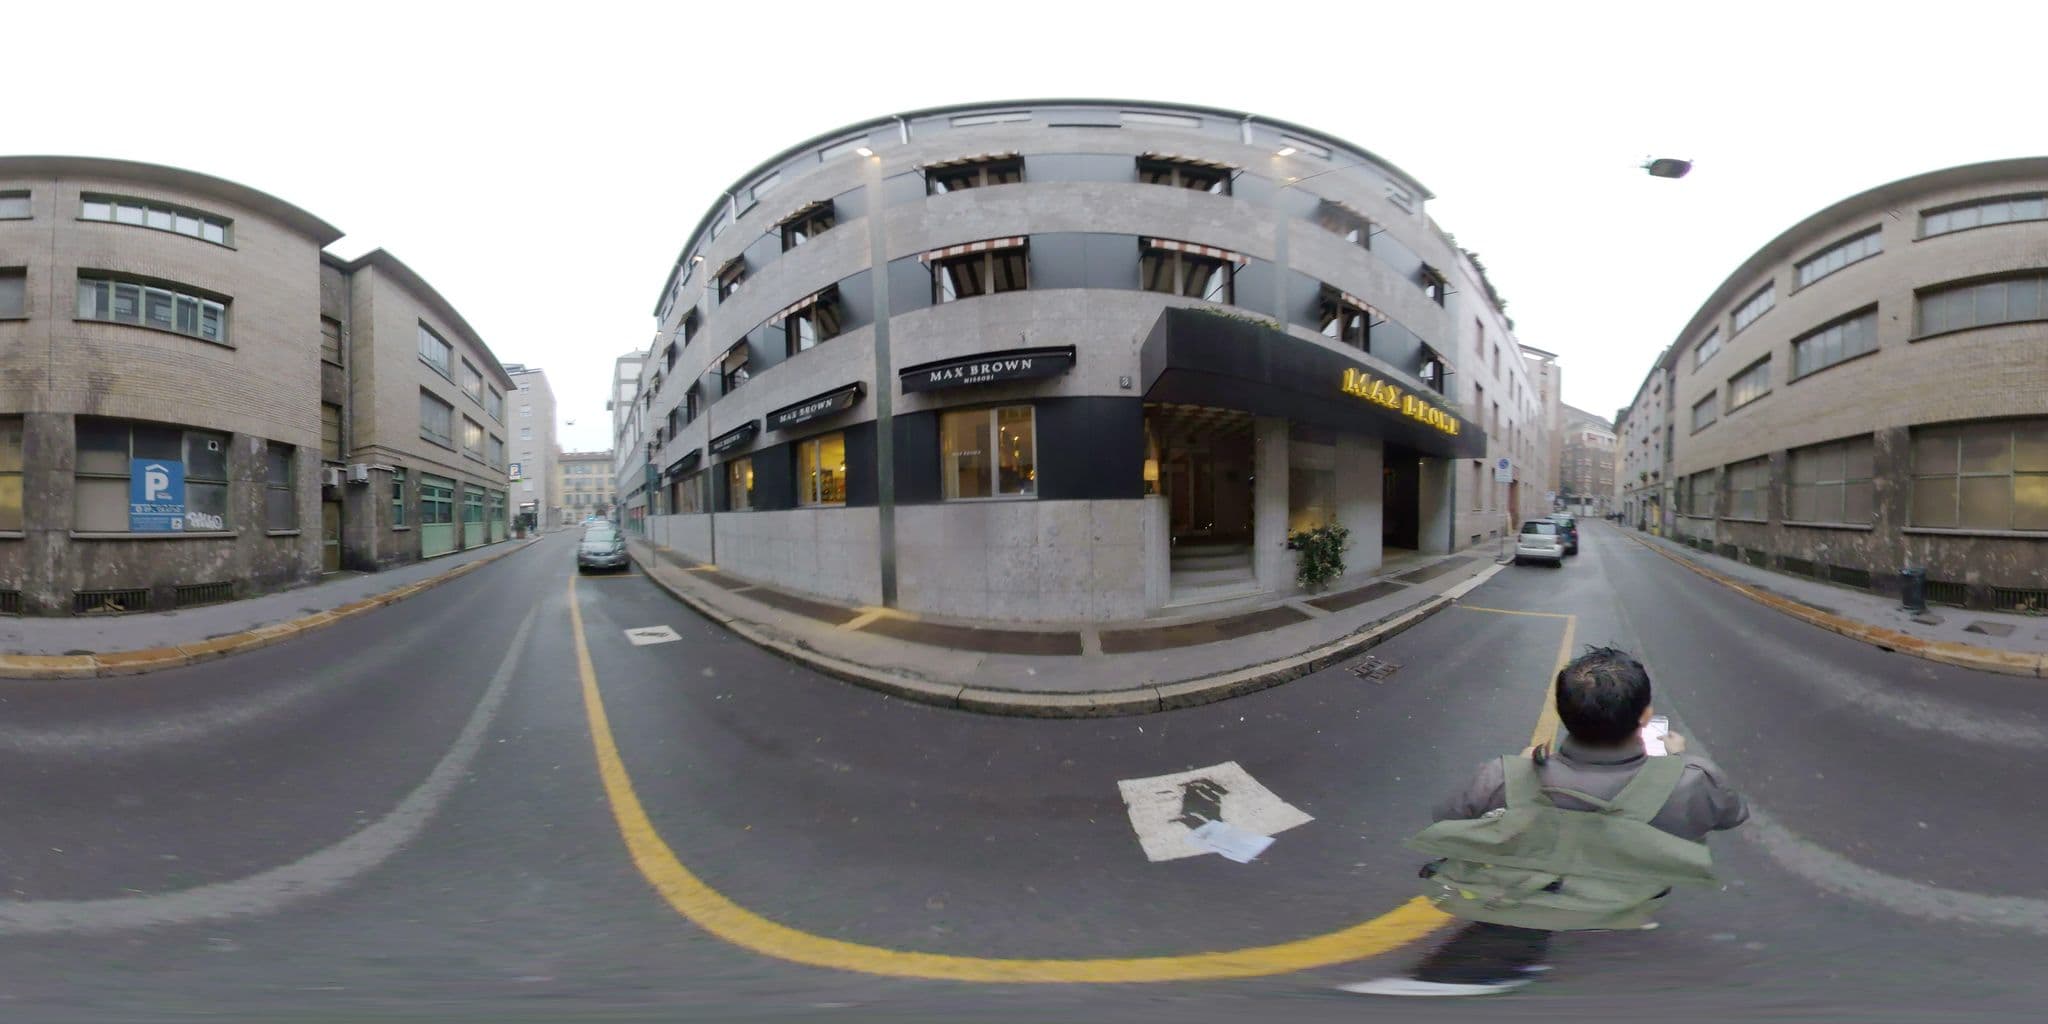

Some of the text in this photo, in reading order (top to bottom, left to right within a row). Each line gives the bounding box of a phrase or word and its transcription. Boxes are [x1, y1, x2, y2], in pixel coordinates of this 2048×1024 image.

[930, 359, 1032, 382] MAX BROWN
[145, 471, 169, 501] P
